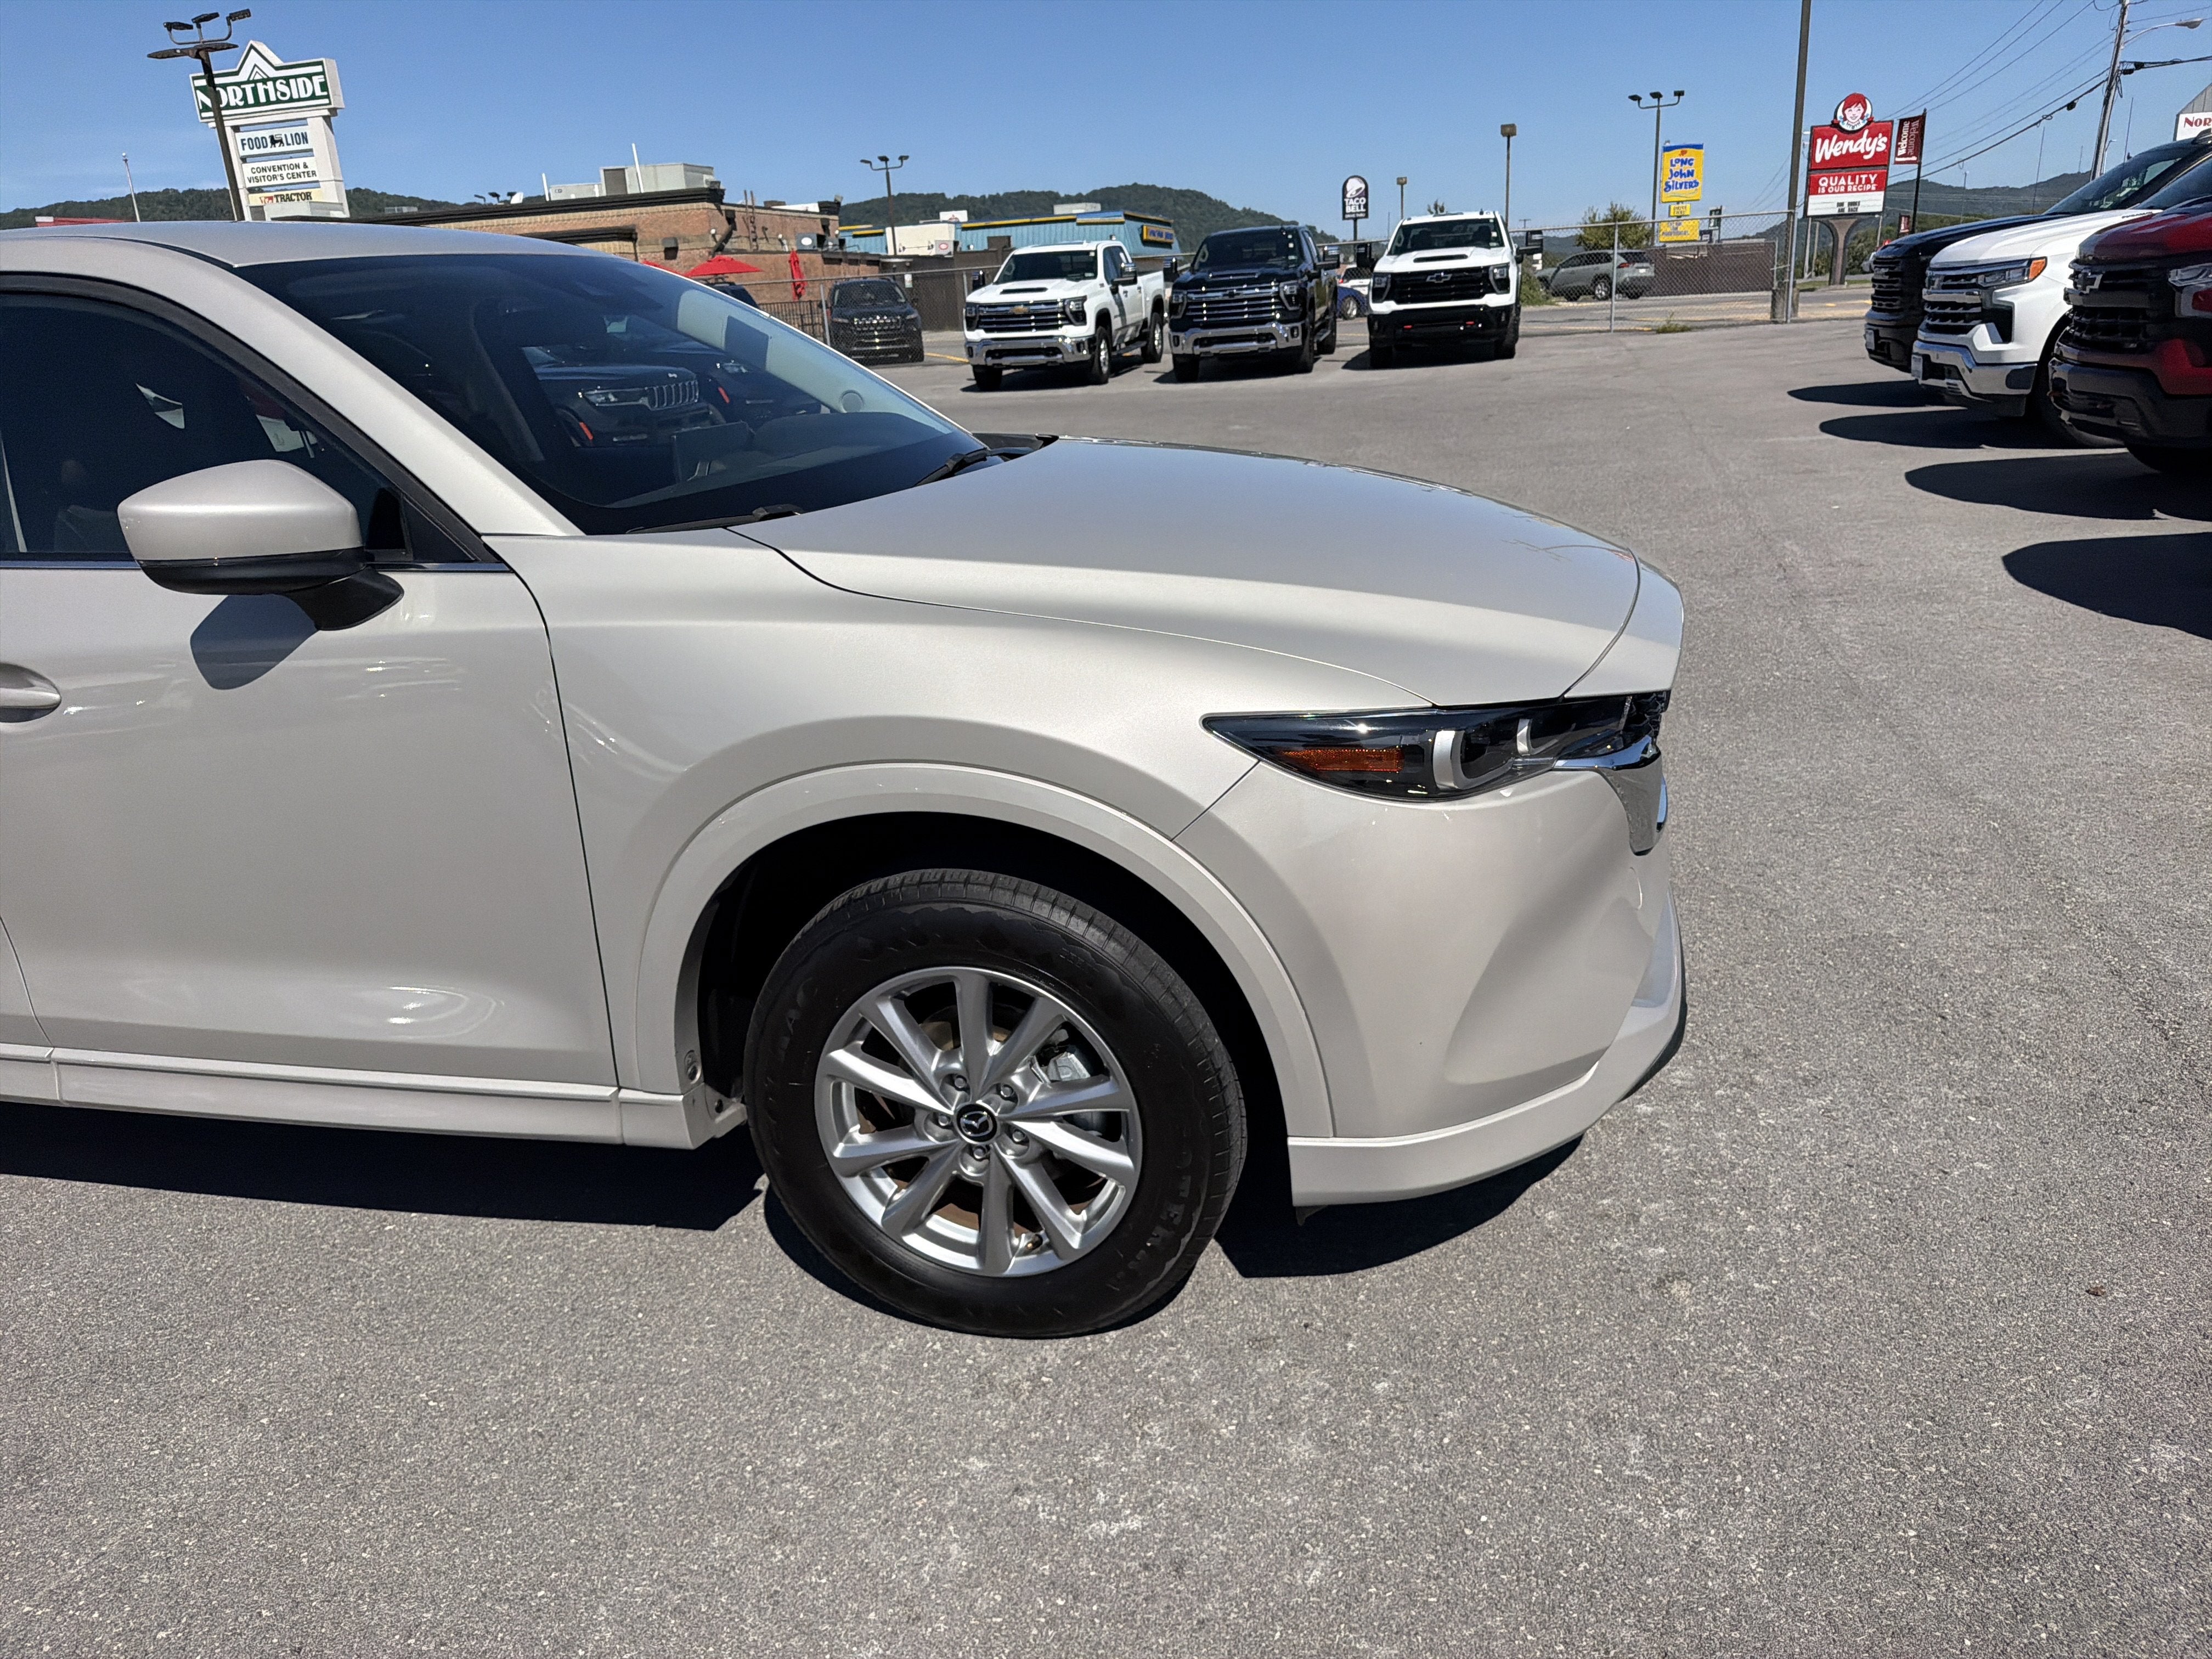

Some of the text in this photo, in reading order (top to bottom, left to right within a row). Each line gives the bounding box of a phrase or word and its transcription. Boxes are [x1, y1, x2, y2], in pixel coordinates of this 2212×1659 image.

[240, 132, 309, 151] FOOD LION
[1898, 121, 1910, 156] Welcome
[1908, 120, 1919, 155] Welcome
[1815, 129, 1888, 163] Wendy's
[251, 162, 300, 174] CONVENTION
[247, 170, 317, 183] VISITOR'S CENTER
[1819, 173, 1877, 187] QUALITY
[274, 191, 313, 202] TRACTOR
[1344, 197, 1366, 206] TACO
[1346, 204, 1366, 213] BELL
